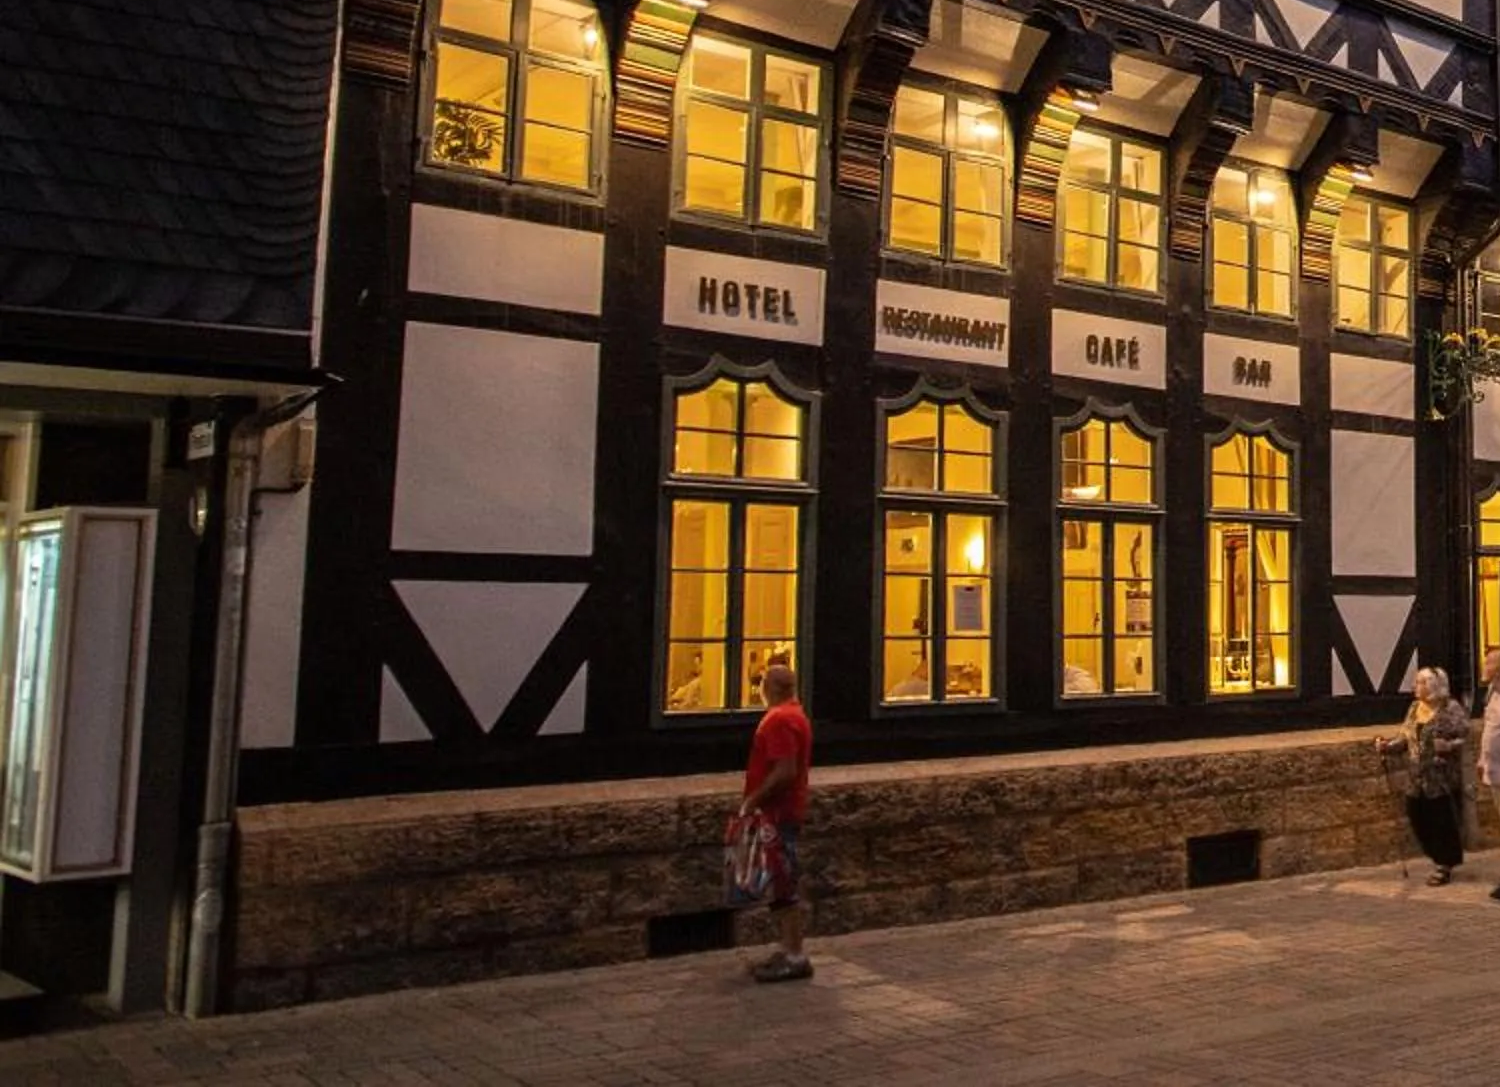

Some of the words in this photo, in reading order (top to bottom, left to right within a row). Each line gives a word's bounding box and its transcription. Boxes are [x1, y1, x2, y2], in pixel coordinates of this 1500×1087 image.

[697, 276, 798, 325] HOTEL
[880, 305, 1007, 351] RESTAURANT
[1085, 334, 1140, 370] CAFÉ
[1232, 356, 1272, 388] BAR
